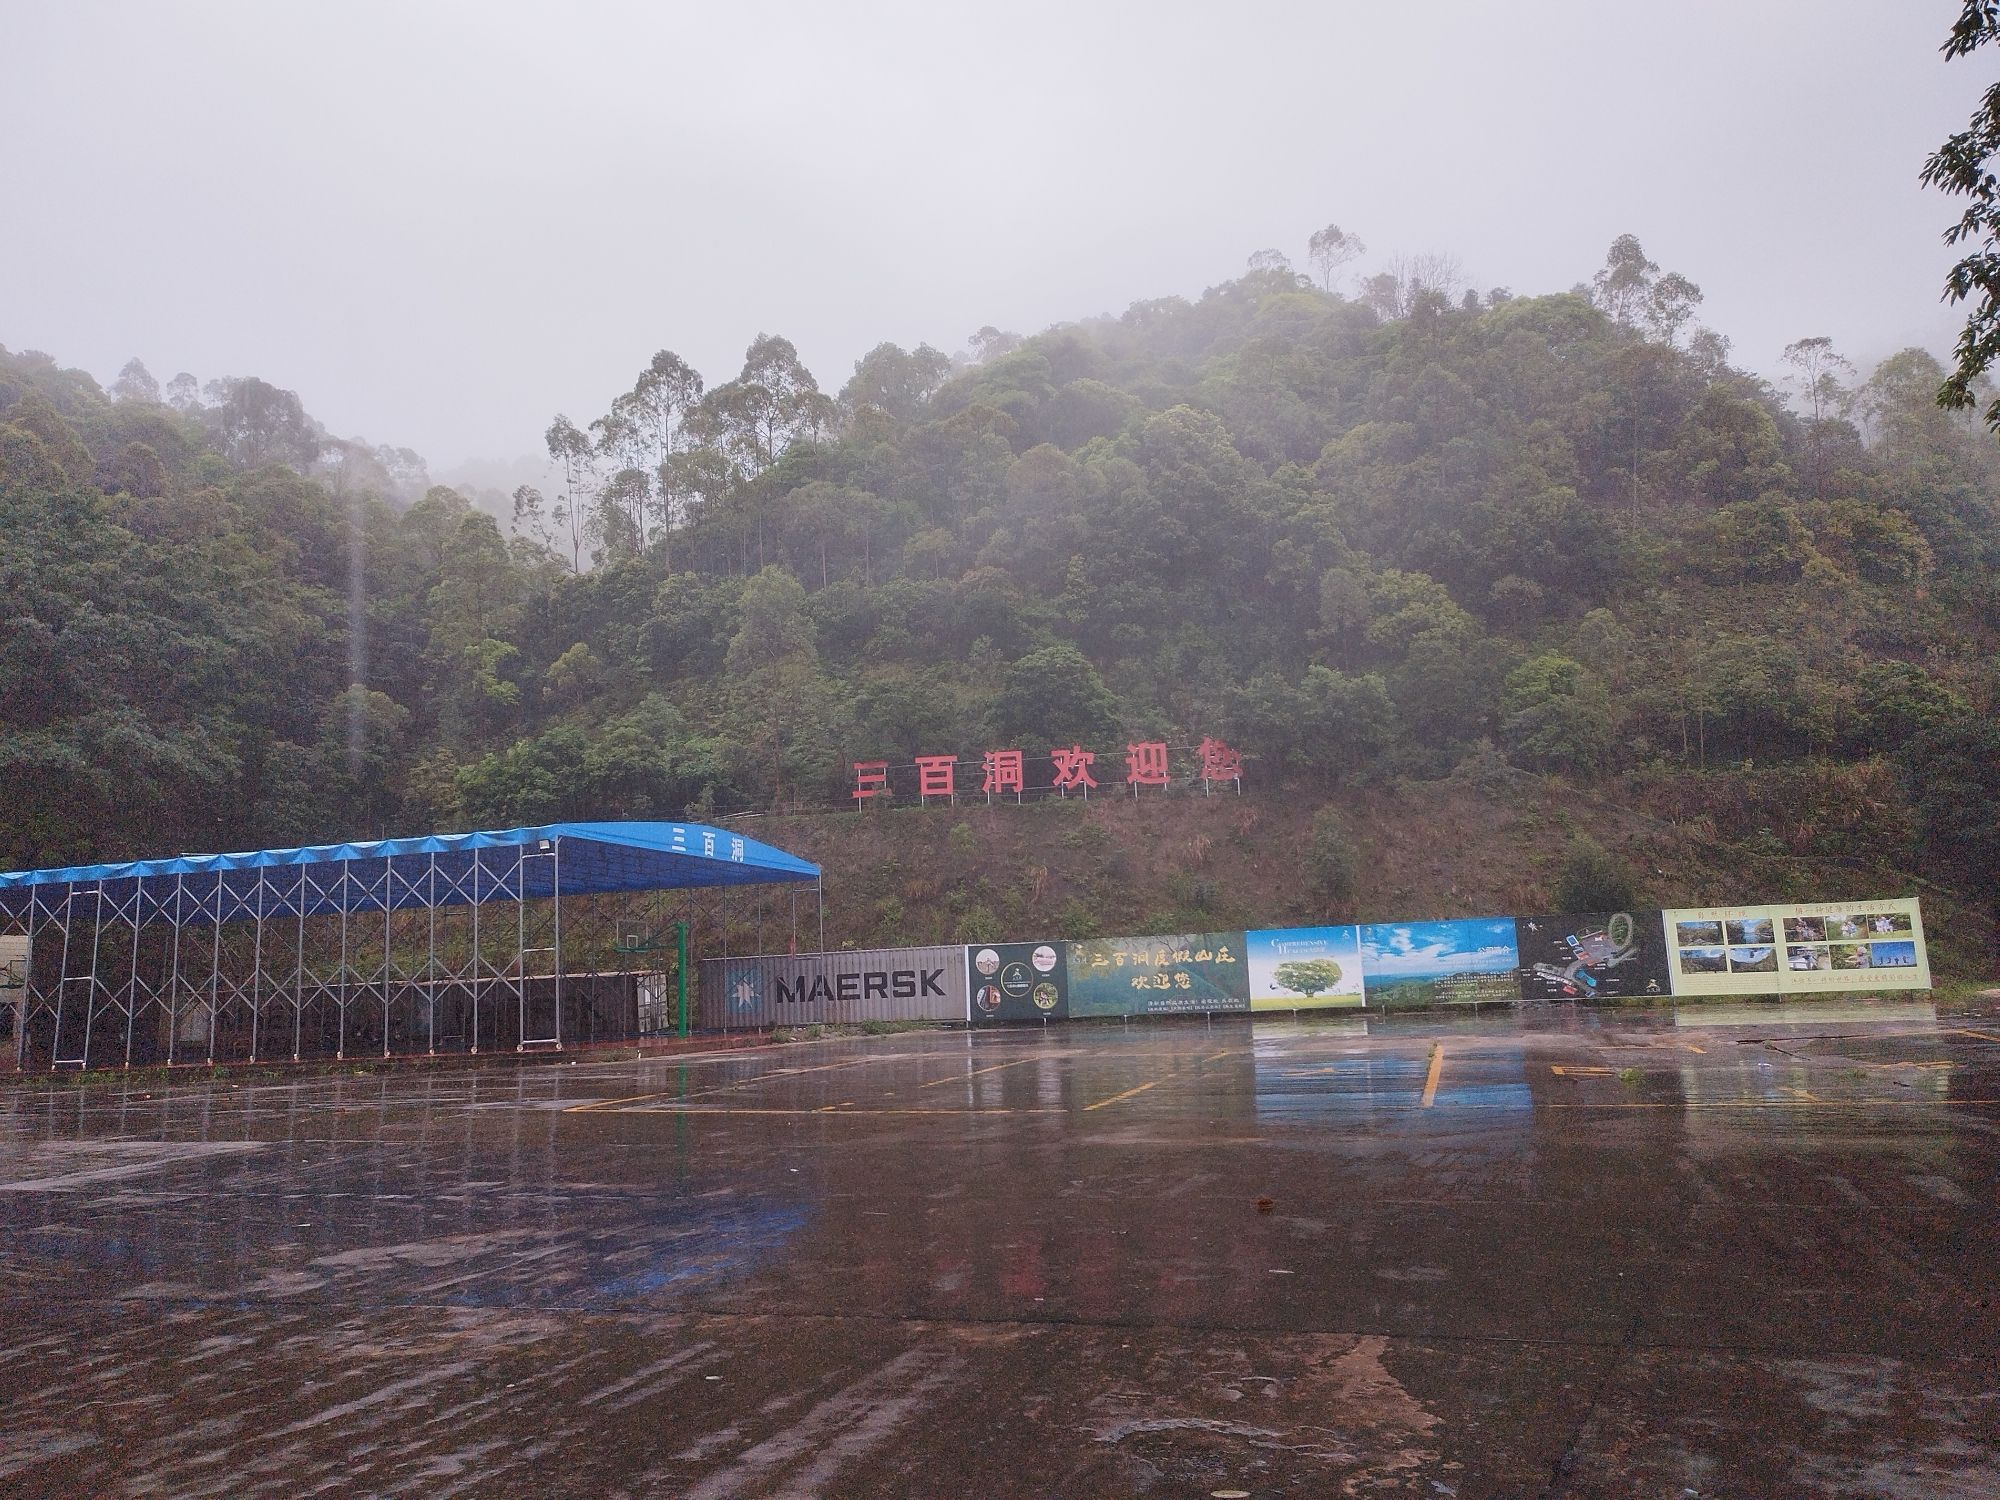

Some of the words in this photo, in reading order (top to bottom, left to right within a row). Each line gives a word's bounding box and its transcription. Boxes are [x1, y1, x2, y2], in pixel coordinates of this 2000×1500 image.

[852, 737, 1243, 799] 三百洞欢迎您
[671, 827, 745, 862] 三百洞
[775, 969, 946, 1004] MAERSK
[1131, 972, 1192, 990] 欢迎您
